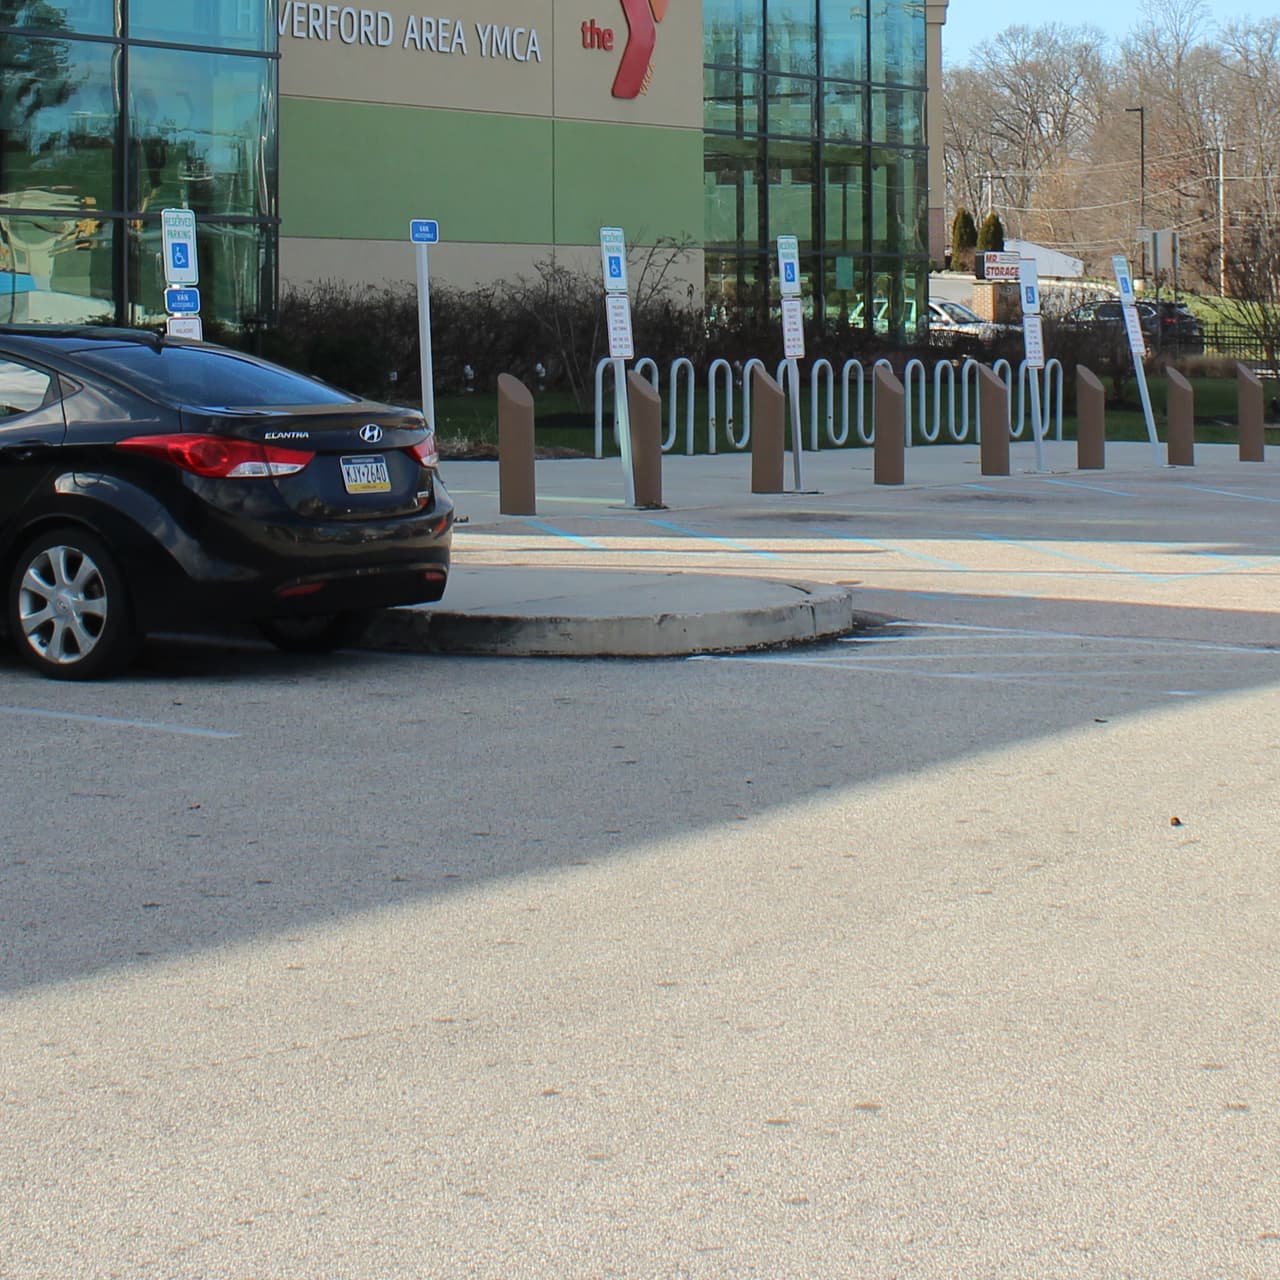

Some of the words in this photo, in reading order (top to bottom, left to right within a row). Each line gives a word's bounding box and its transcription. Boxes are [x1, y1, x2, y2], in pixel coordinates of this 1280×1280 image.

[403, 14, 467, 55] AREA
[475, 23, 542, 63] YMCA
[581, 19, 614, 52] the
[165, 217, 193, 227] RESERVED
[167, 229, 192, 240] PARKING
[985, 266, 1020, 277] STORAGE
[176, 294, 189, 302] VAN
[264, 431, 310, 440] ELANTRA
